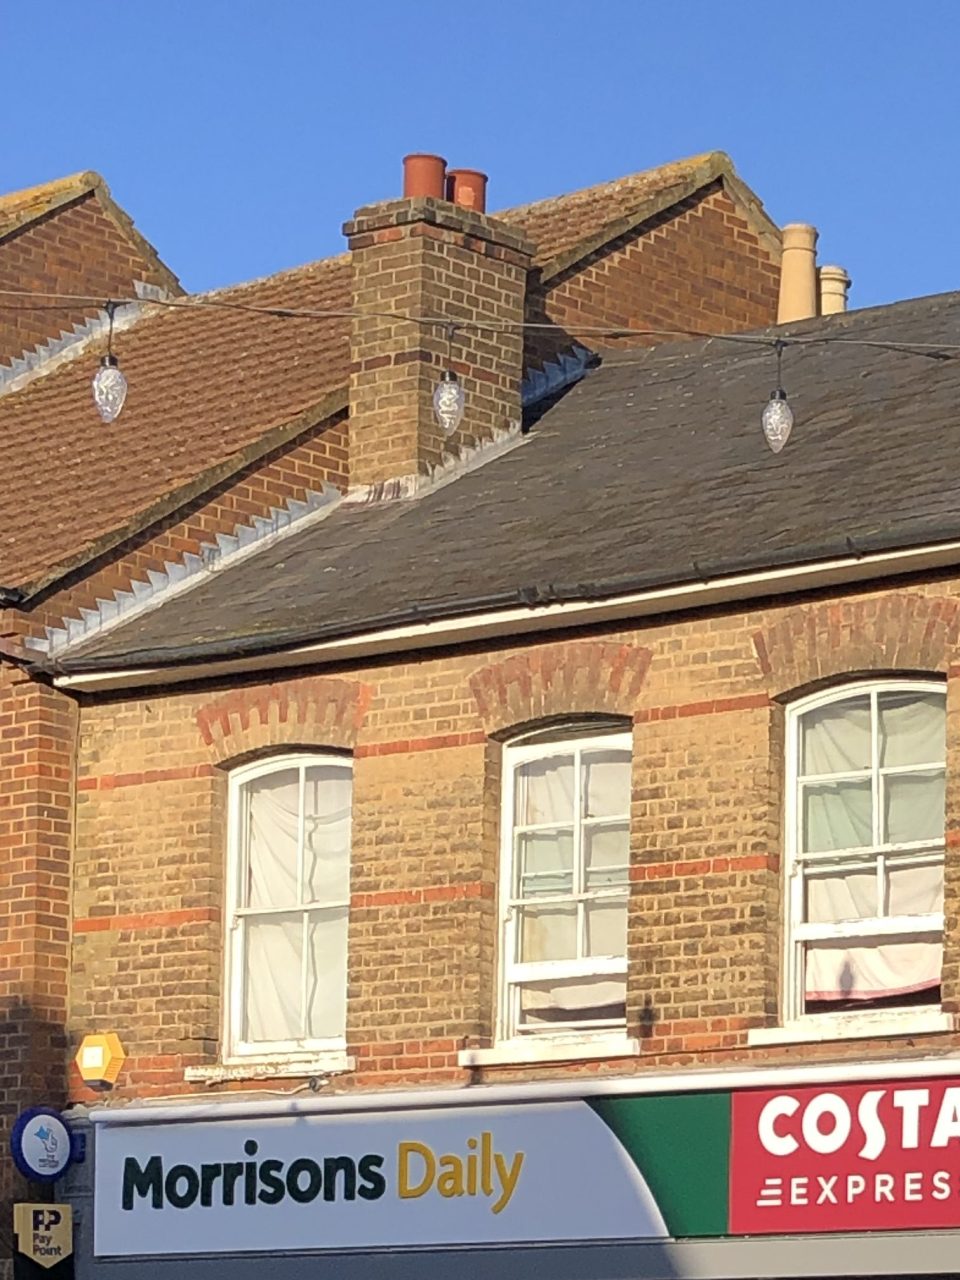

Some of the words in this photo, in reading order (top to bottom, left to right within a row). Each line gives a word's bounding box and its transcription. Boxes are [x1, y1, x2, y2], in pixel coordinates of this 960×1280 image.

[122, 1139, 386, 1211] Morrisons
[398, 1132, 525, 1215] Daily
[33, 1233, 51, 1245] Pay
[33, 1245, 62, 1256] Point
